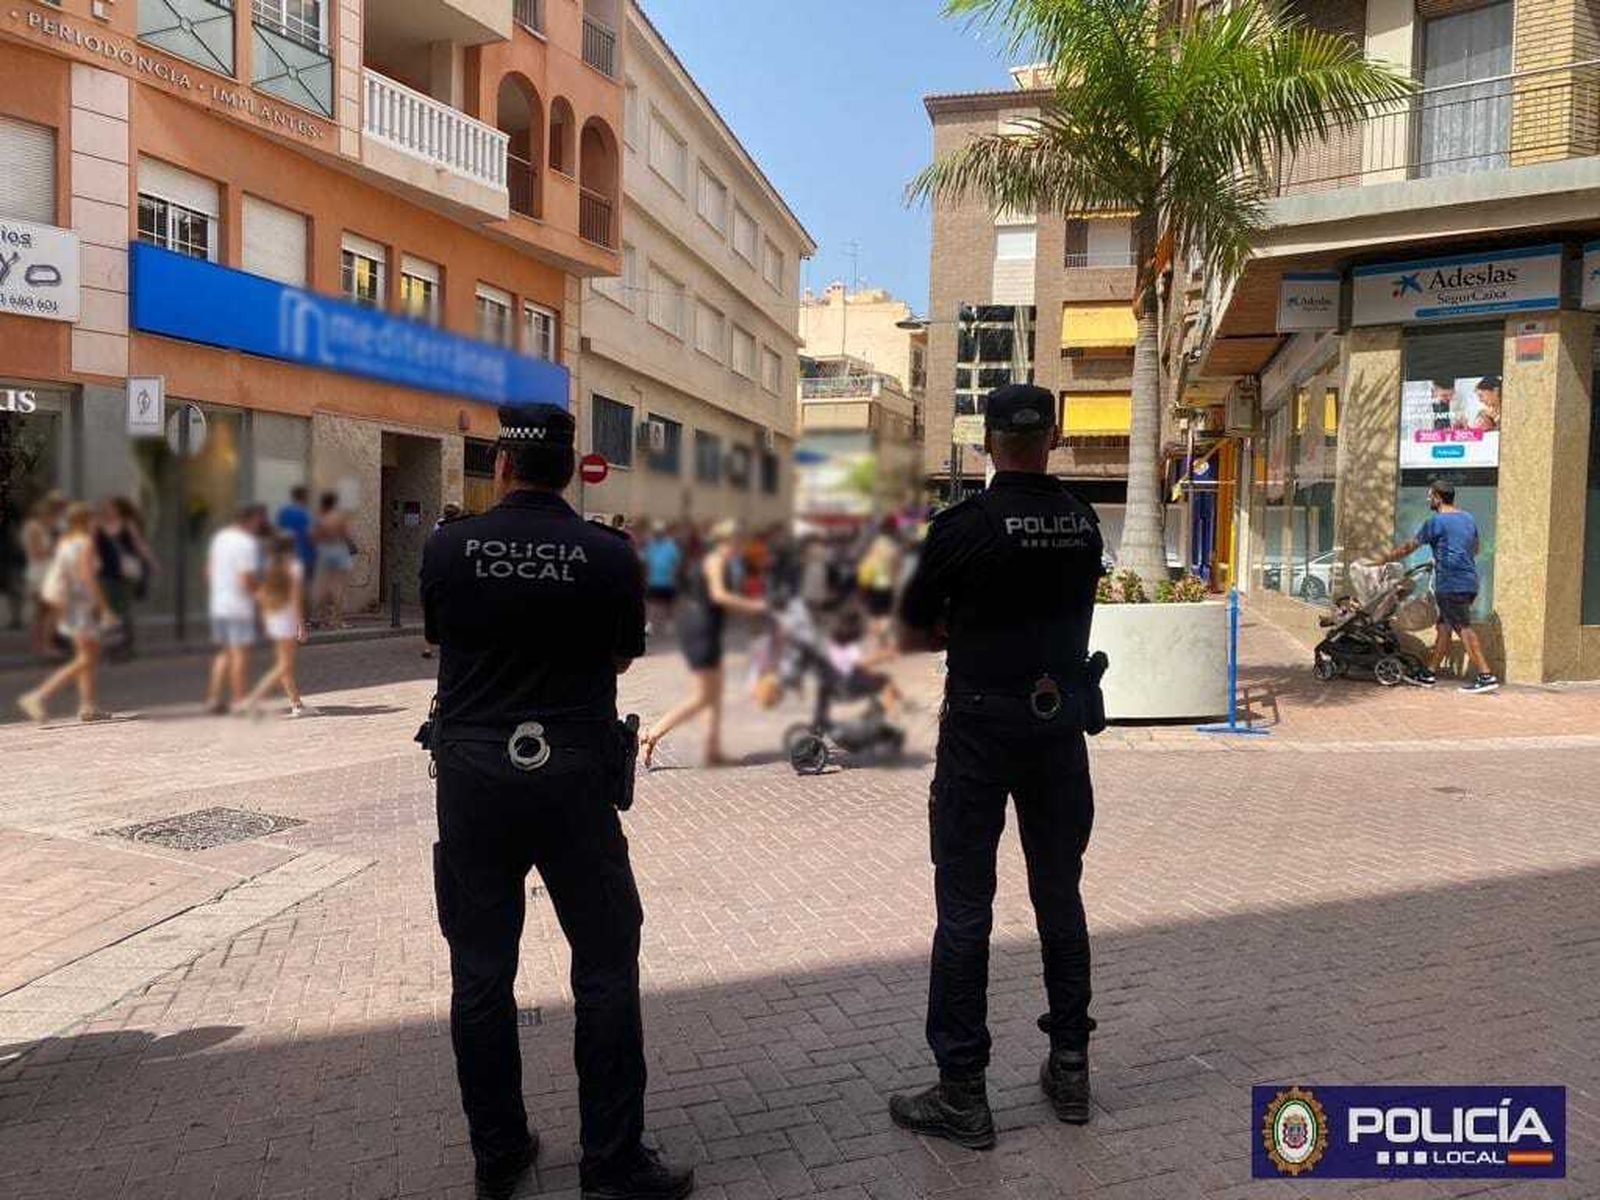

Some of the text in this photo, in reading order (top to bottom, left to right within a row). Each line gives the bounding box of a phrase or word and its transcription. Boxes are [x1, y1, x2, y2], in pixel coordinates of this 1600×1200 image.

[28, 12, 191, 88] PERIODONCIA
[1427, 263, 1519, 289] Adeslas
[464, 538, 588, 564] POLICIA
[1051, 537, 1089, 549] LOCAL
[475, 560, 576, 582] LOCAL
